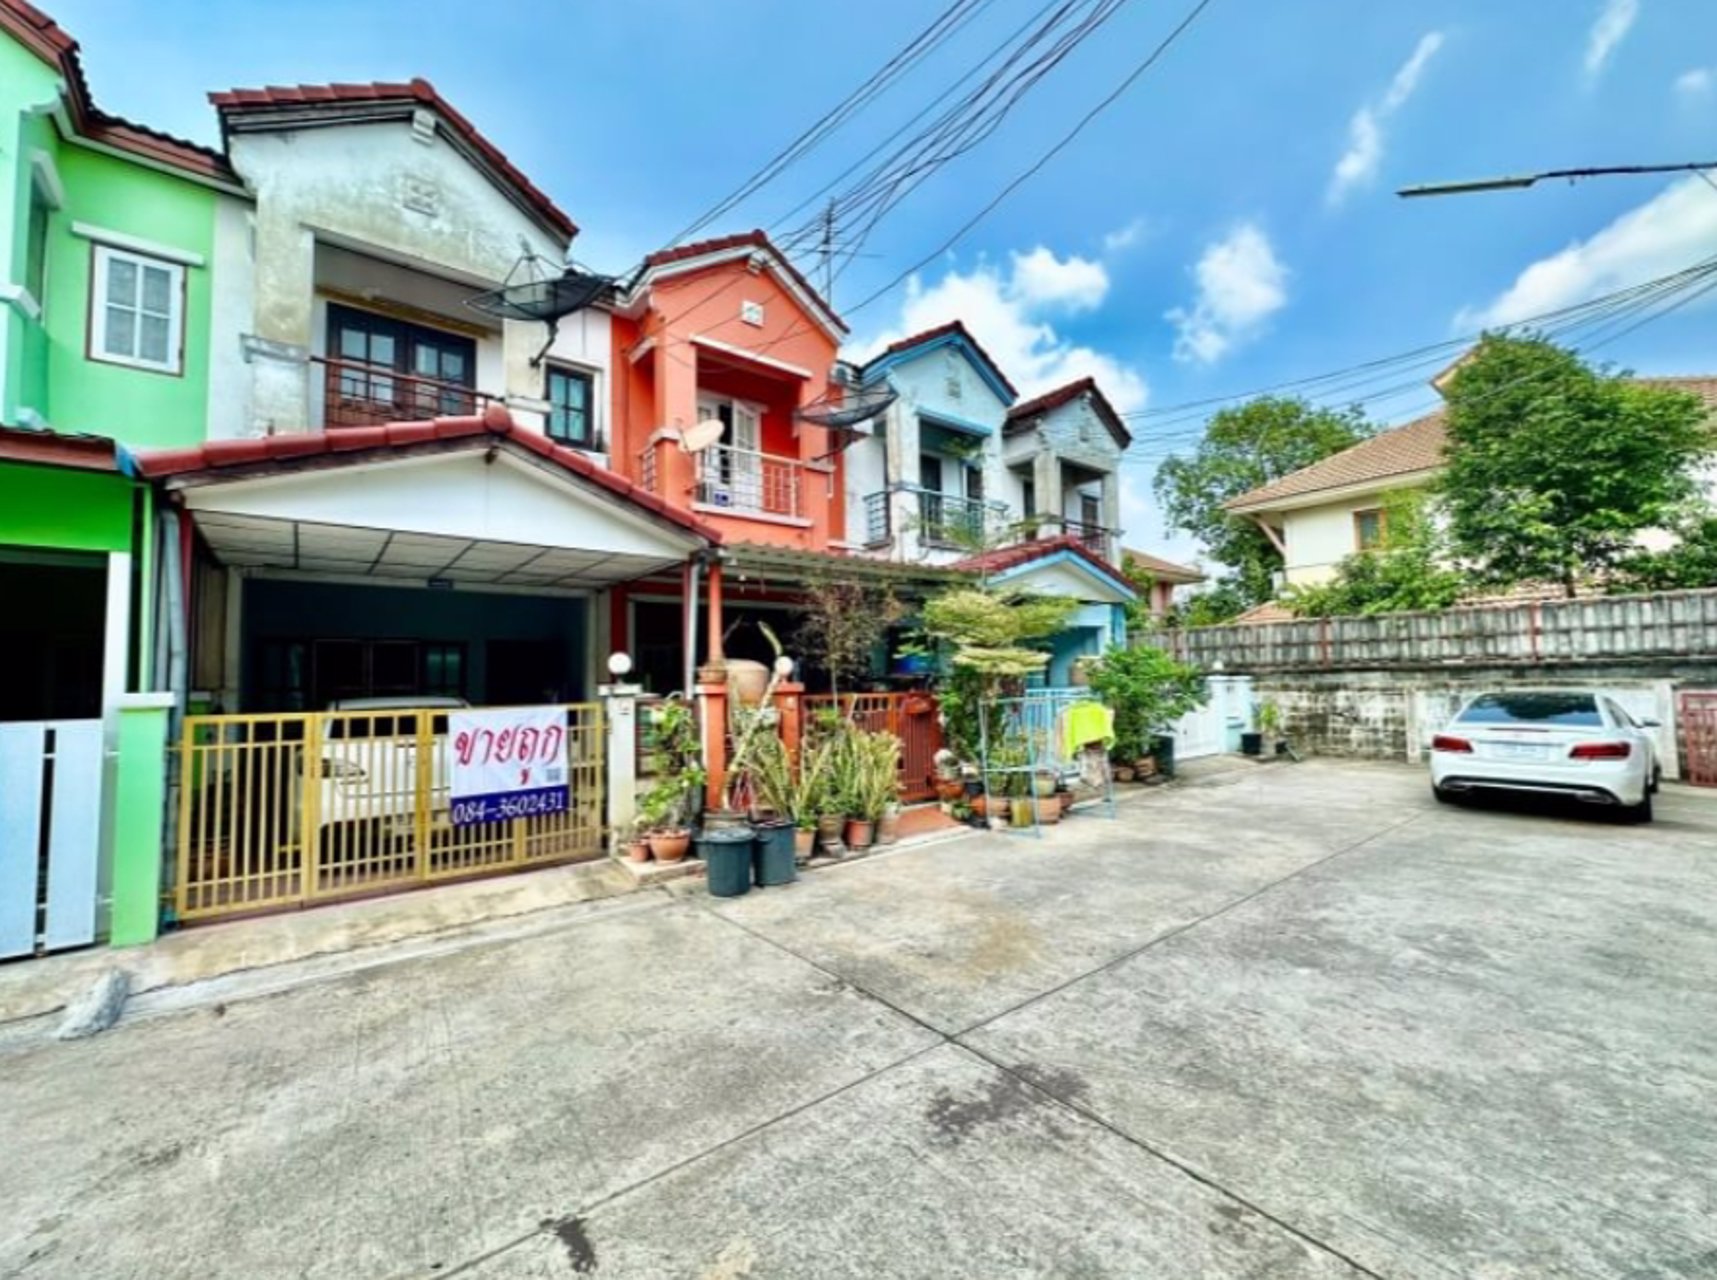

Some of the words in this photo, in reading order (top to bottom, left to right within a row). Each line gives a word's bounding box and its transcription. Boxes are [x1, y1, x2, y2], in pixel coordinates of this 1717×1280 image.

[455, 725, 563, 785] ขายถูก
[452, 791, 563, 824] 084-3602431
